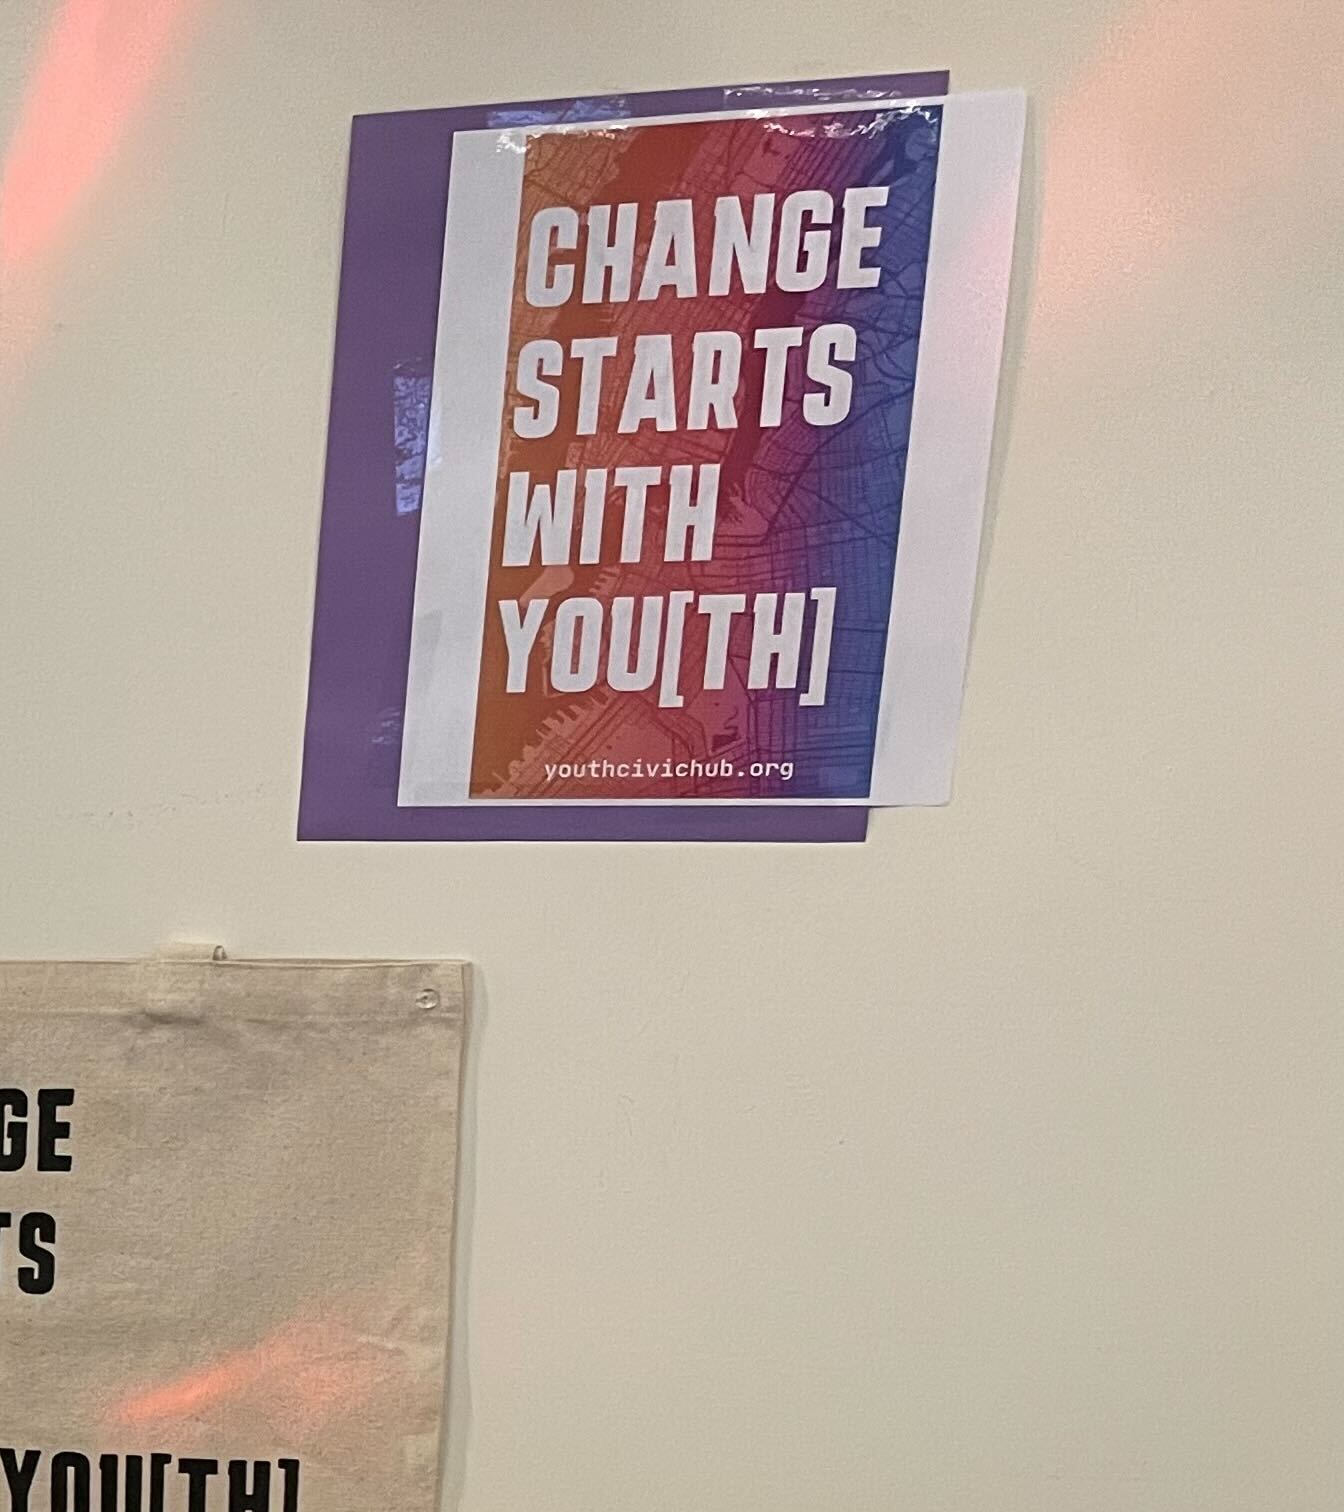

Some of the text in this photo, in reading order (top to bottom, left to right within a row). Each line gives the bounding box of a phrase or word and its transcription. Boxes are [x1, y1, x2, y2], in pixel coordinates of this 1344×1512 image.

[524, 187, 890, 309] CHANGE
[514, 324, 858, 440] STARTS
[501, 463, 721, 567] WITH
[498, 587, 836, 708] YOU[TH]
[544, 759, 794, 781] youthcivichub.org
